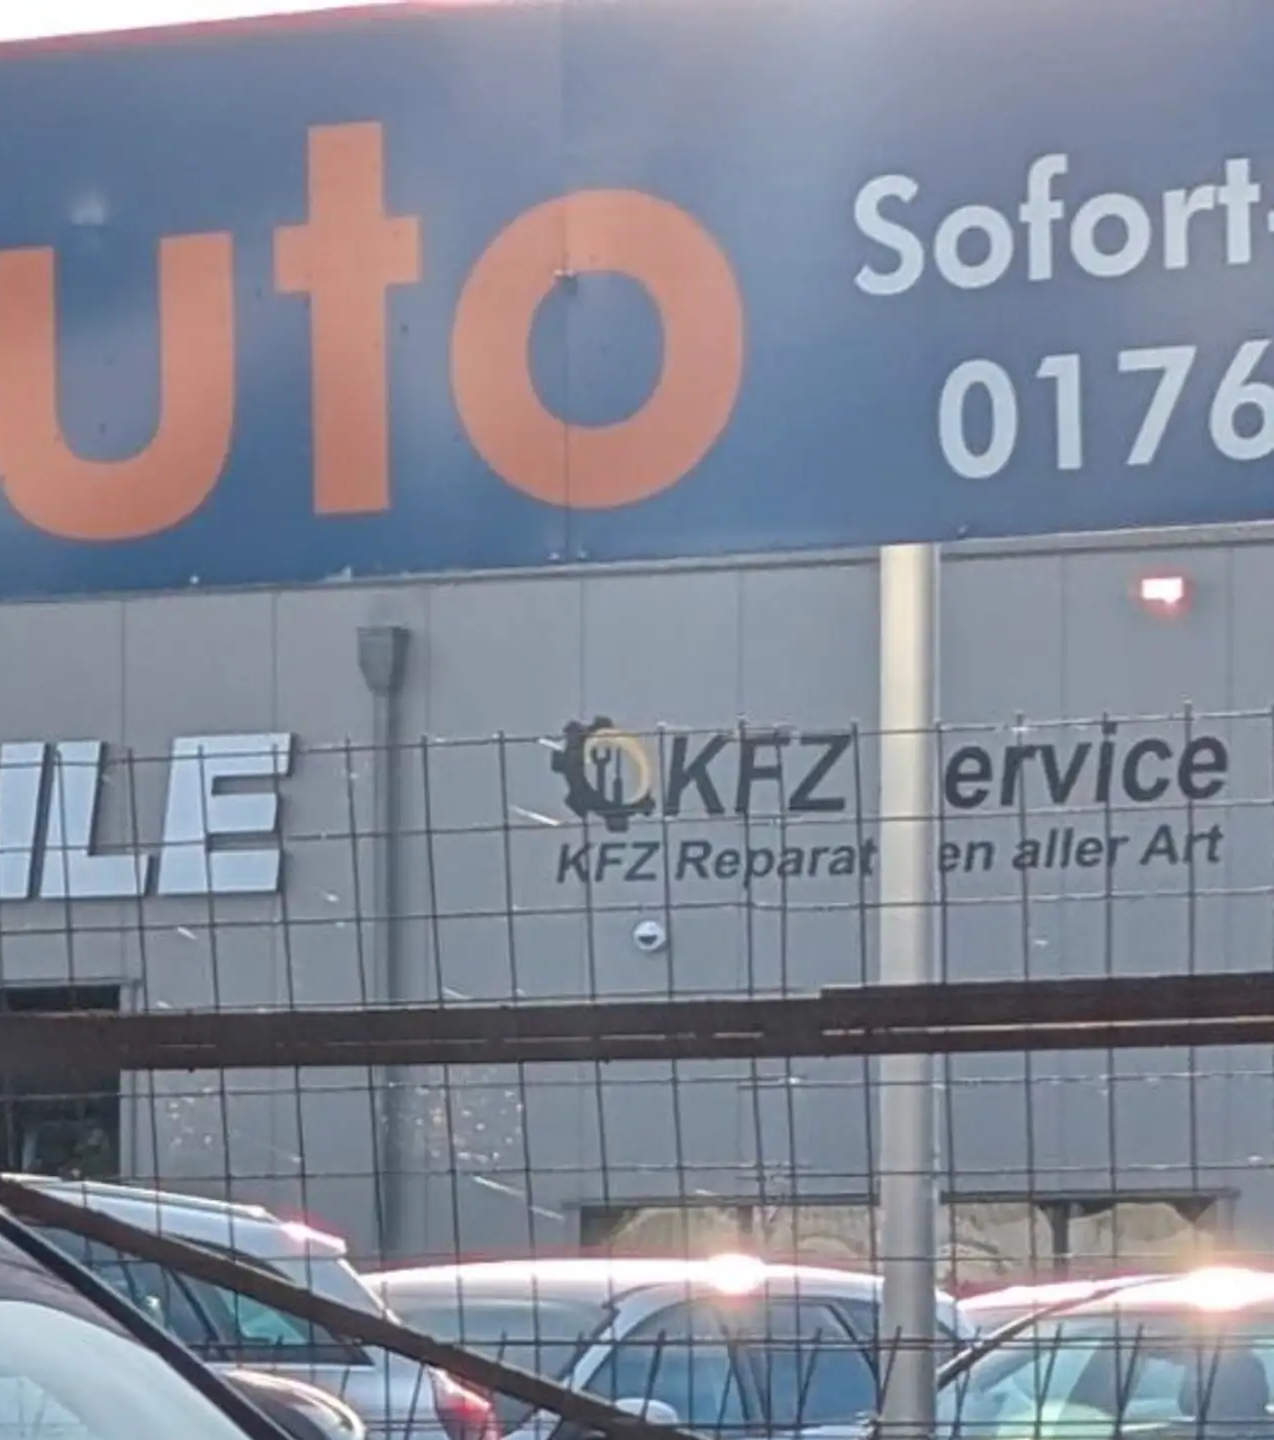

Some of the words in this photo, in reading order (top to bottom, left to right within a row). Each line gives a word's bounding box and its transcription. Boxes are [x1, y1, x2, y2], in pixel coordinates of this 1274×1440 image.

[854, 153, 1274, 295] Sofort
[939, 338, 1274, 479] 0176
[664, 734, 851, 815] KFZ
[944, 722, 1229, 809] ervice
[556, 842, 660, 883] KFZ
[1012, 827, 1129, 870] aller
[1139, 823, 1224, 866] Art
